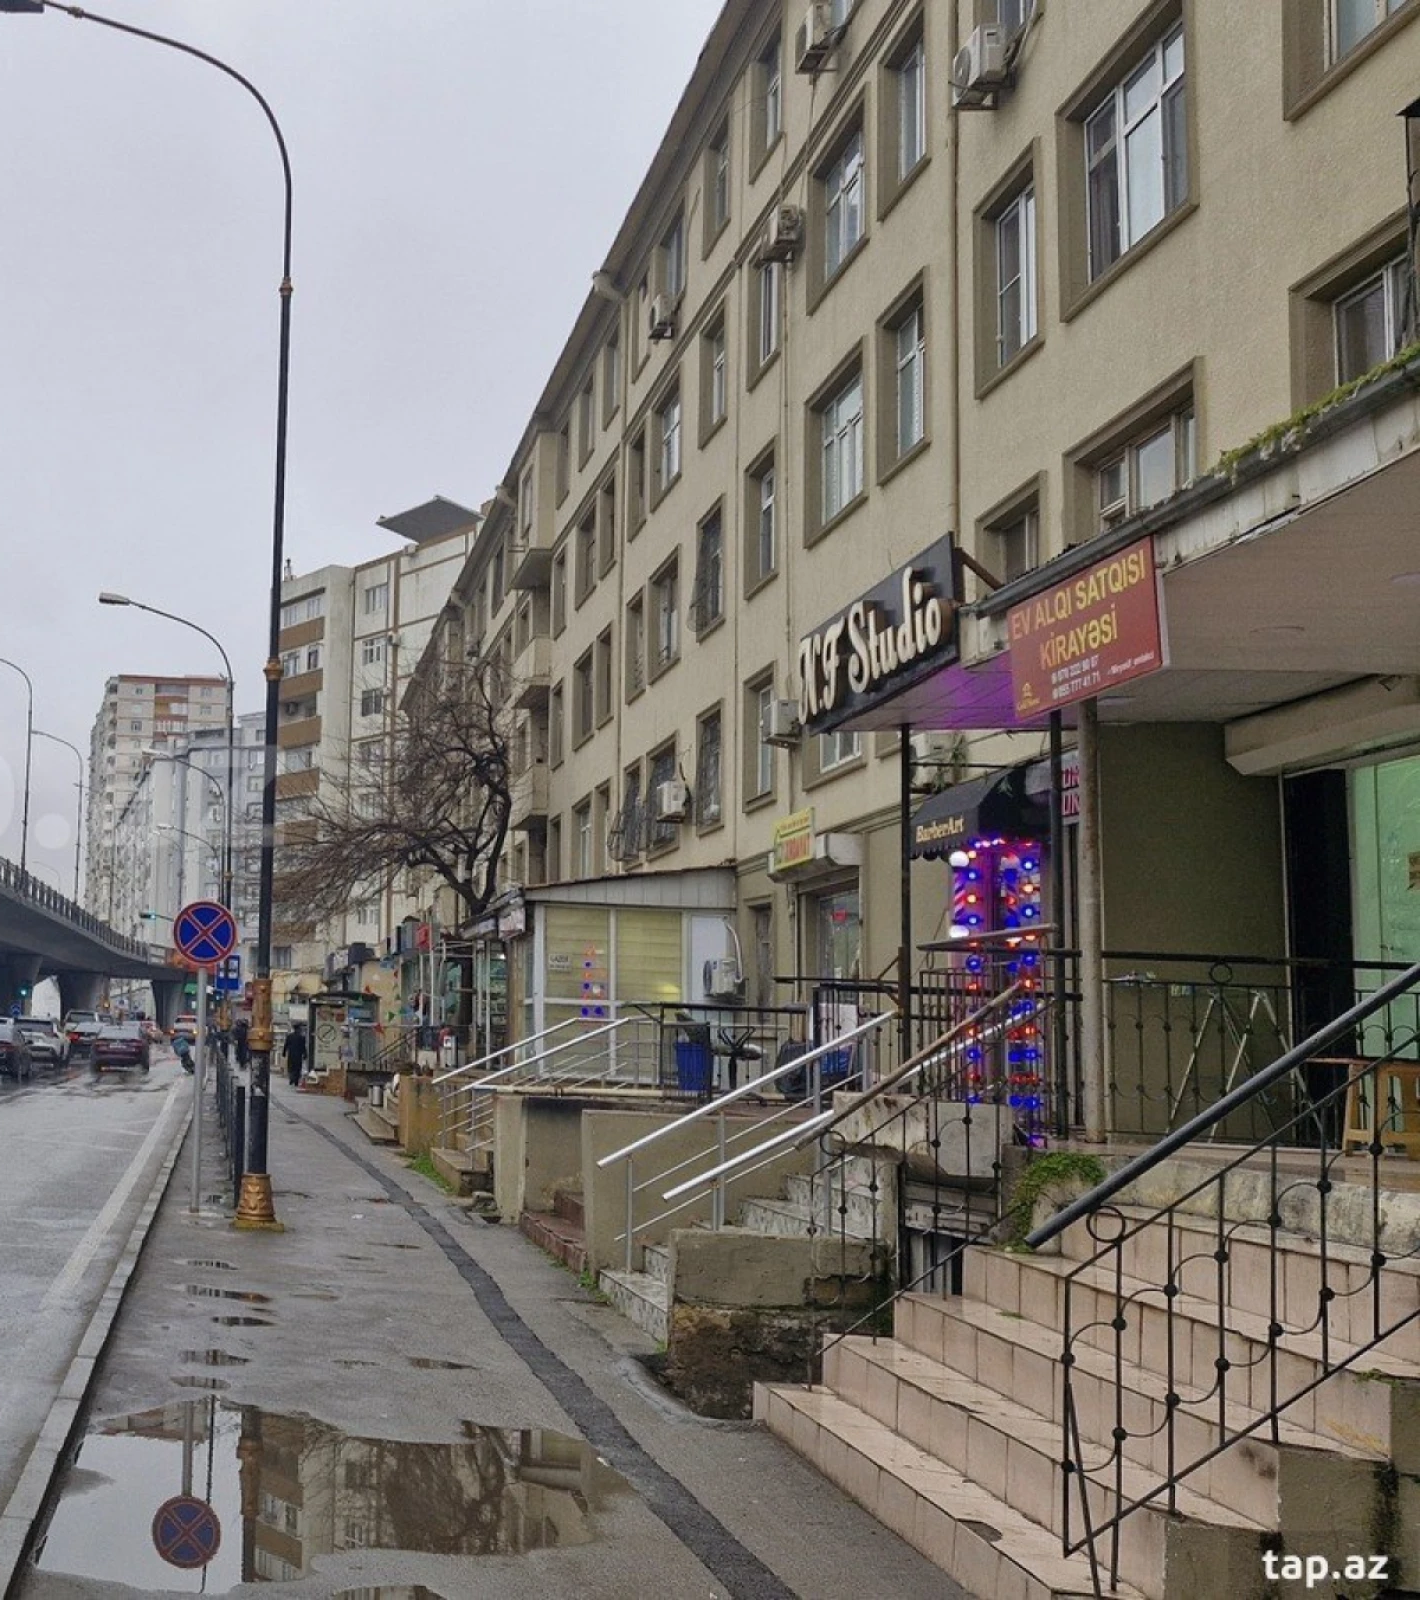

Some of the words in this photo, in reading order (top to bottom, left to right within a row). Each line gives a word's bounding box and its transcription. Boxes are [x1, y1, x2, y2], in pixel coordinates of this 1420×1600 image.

[848, 566, 941, 693] Studio
[1011, 606, 1030, 640] EV
[1034, 587, 1072, 630] ALQI
[1075, 549, 1145, 610] SATQISI
[916, 814, 964, 842] BarberArt
